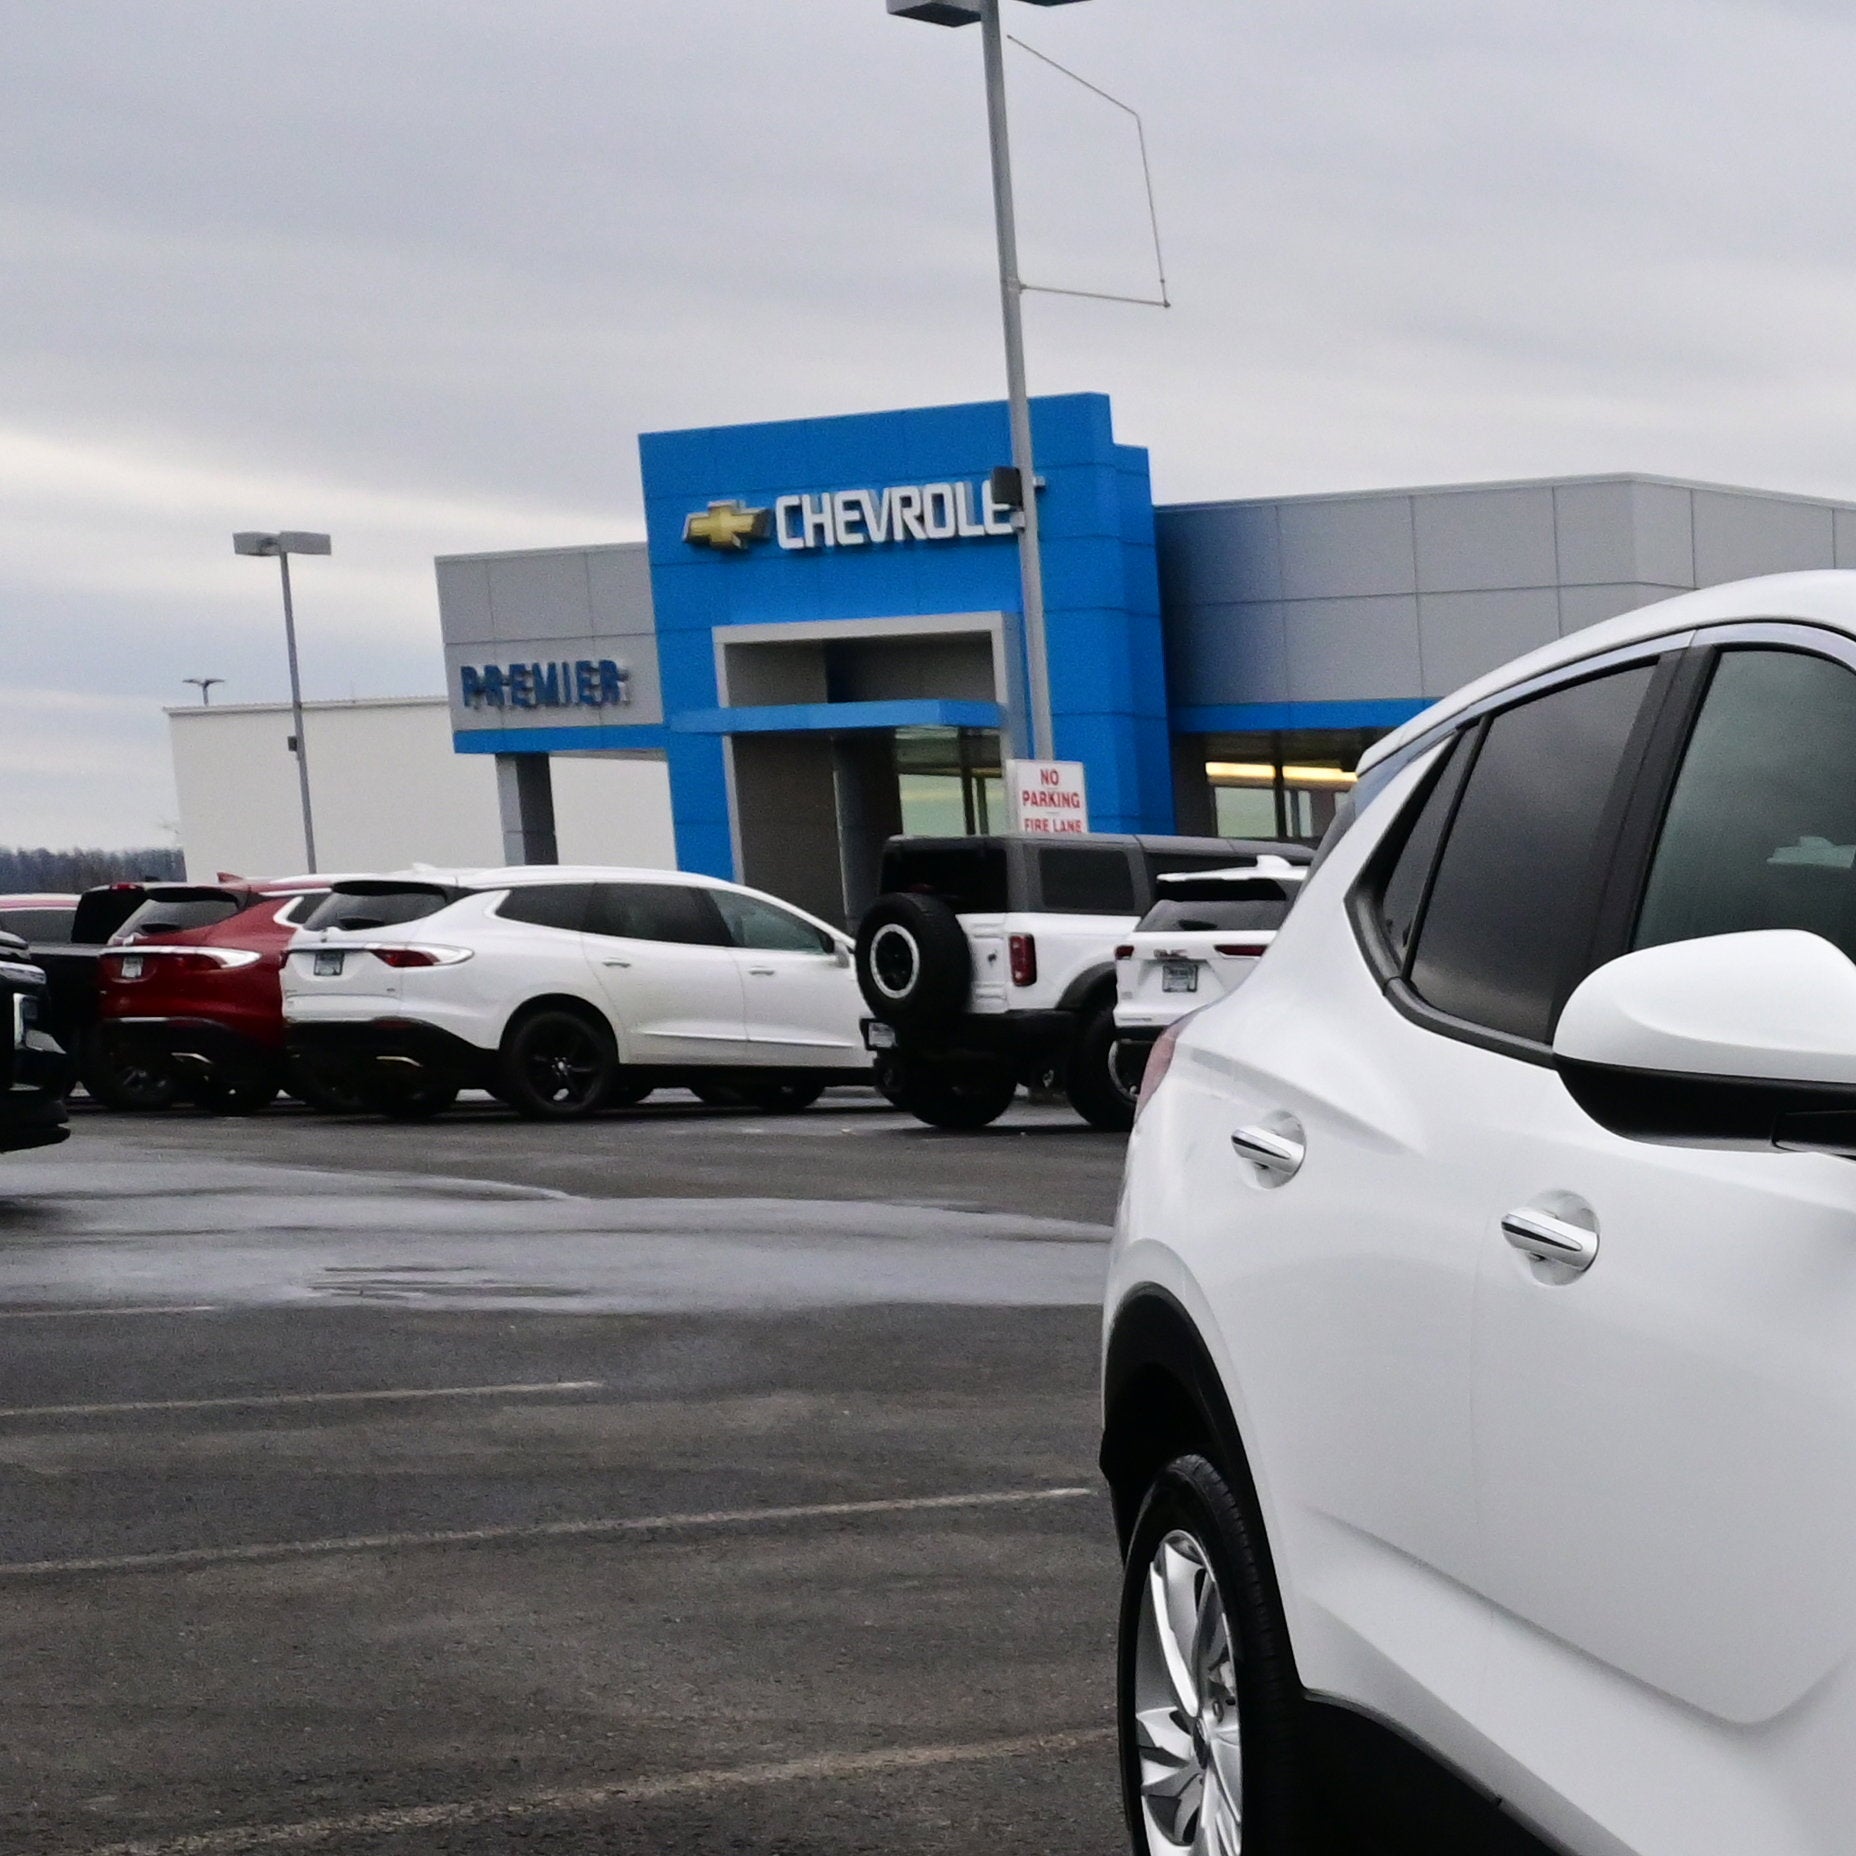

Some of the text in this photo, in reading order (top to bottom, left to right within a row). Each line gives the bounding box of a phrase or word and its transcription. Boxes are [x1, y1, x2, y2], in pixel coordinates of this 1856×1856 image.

[776, 475, 1046, 549] CHEVROLE
[461, 659, 630, 708] PREMIER
[1040, 769, 1060, 786] NO
[1022, 790, 1080, 809] PARKING
[1024, 818, 1083, 833] FIRE LANE
